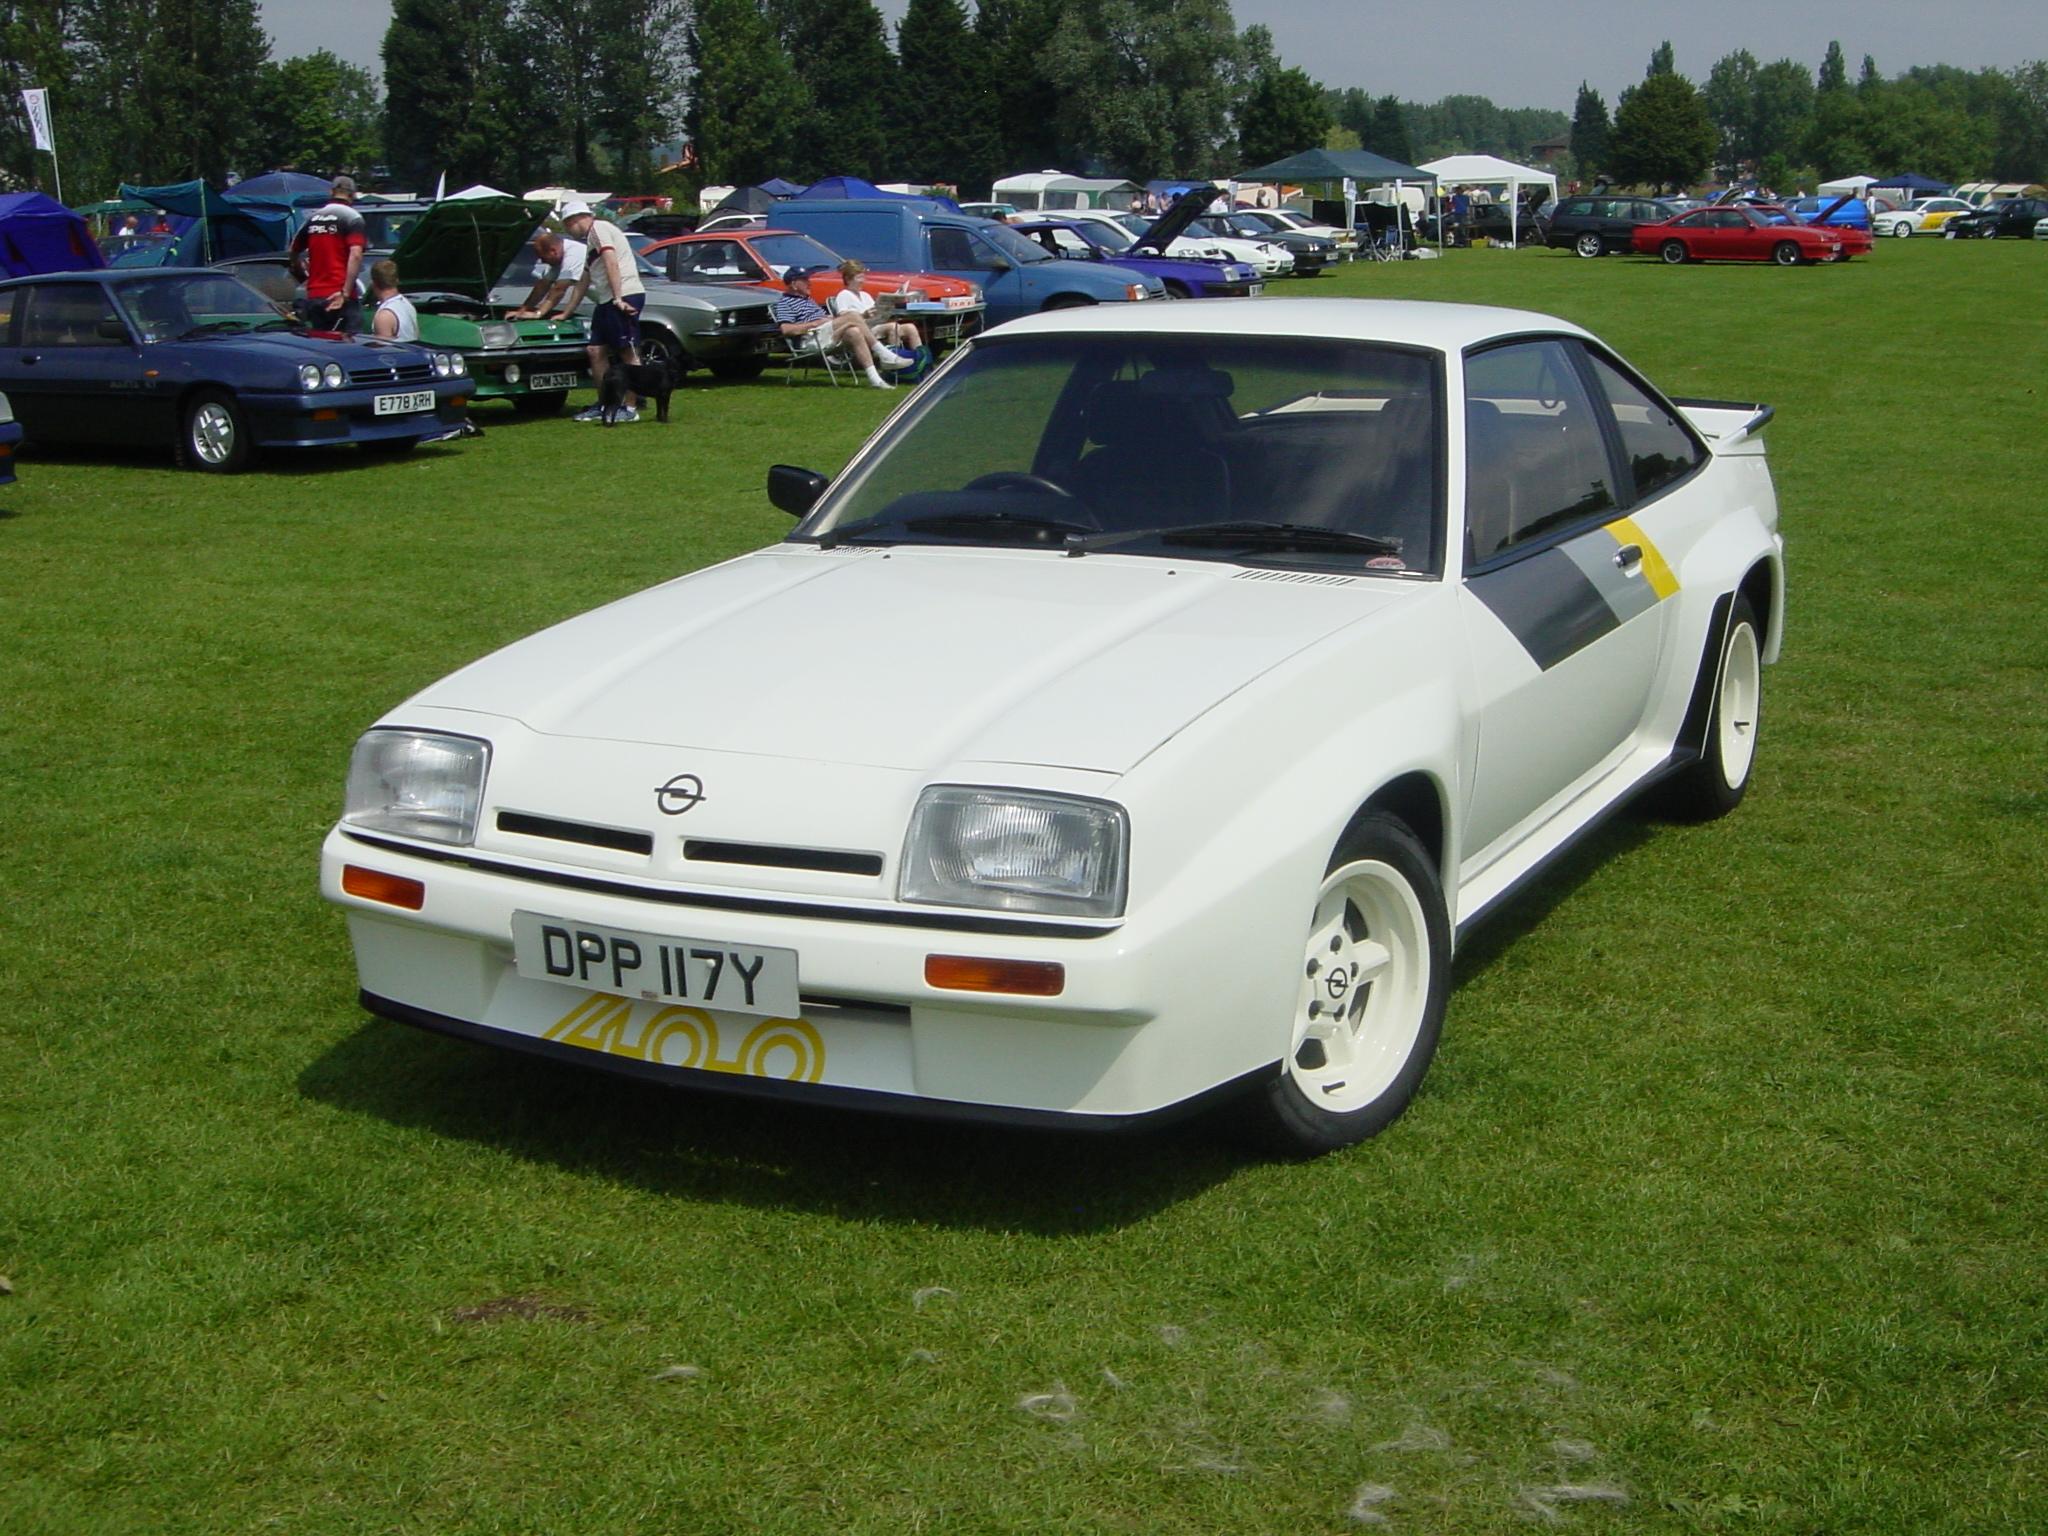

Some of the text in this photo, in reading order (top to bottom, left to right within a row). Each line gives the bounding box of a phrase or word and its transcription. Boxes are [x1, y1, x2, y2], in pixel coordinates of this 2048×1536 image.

[379, 393, 431, 411] E778 XRH
[541, 924, 764, 1006] DPP 117Y
[541, 993, 826, 1084] 400
